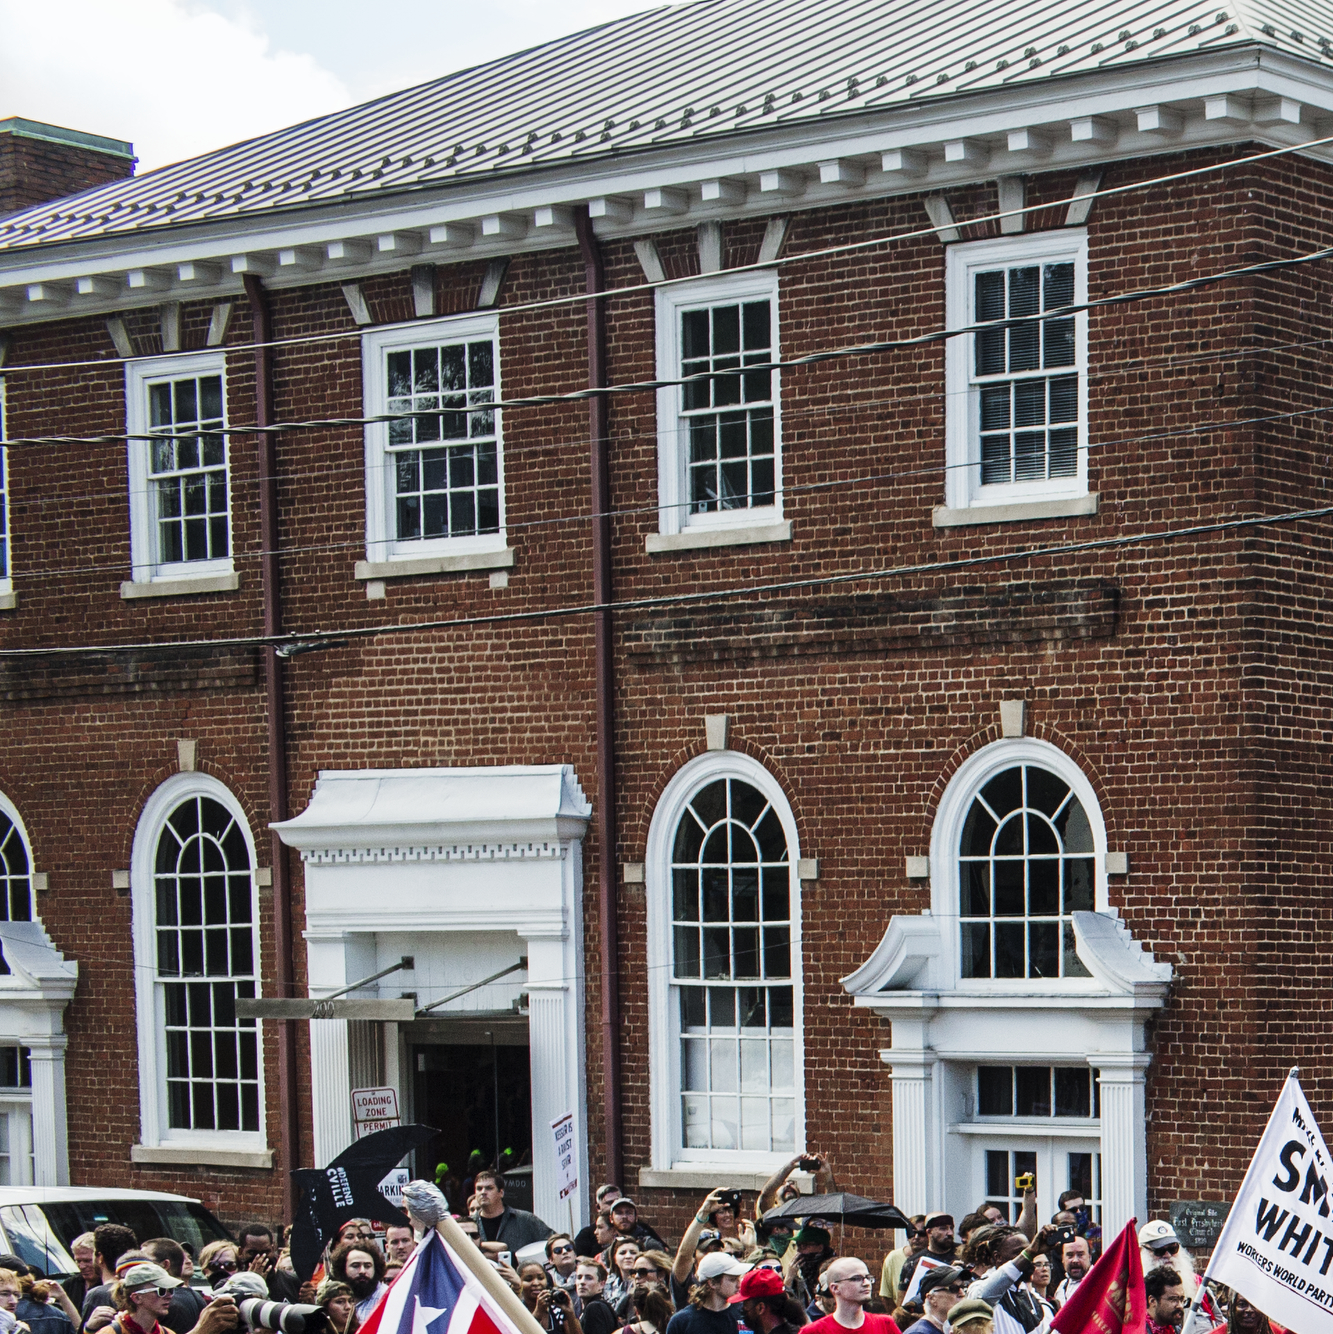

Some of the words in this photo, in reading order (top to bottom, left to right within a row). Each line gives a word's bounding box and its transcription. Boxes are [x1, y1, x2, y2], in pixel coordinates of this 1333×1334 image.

[357, 1096, 391, 1107] LOADING
[366, 1107, 387, 1117] ZONE
[364, 1121, 392, 1131] PERMIT
[326, 1168, 345, 1208] CVILLE
[376, 1185, 405, 1197] ARKIN
[1191, 1216, 1224, 1228] Presbyteri
[1236, 1241, 1273, 1273] WORKERS
[1272, 1264, 1307, 1291] WORLD
